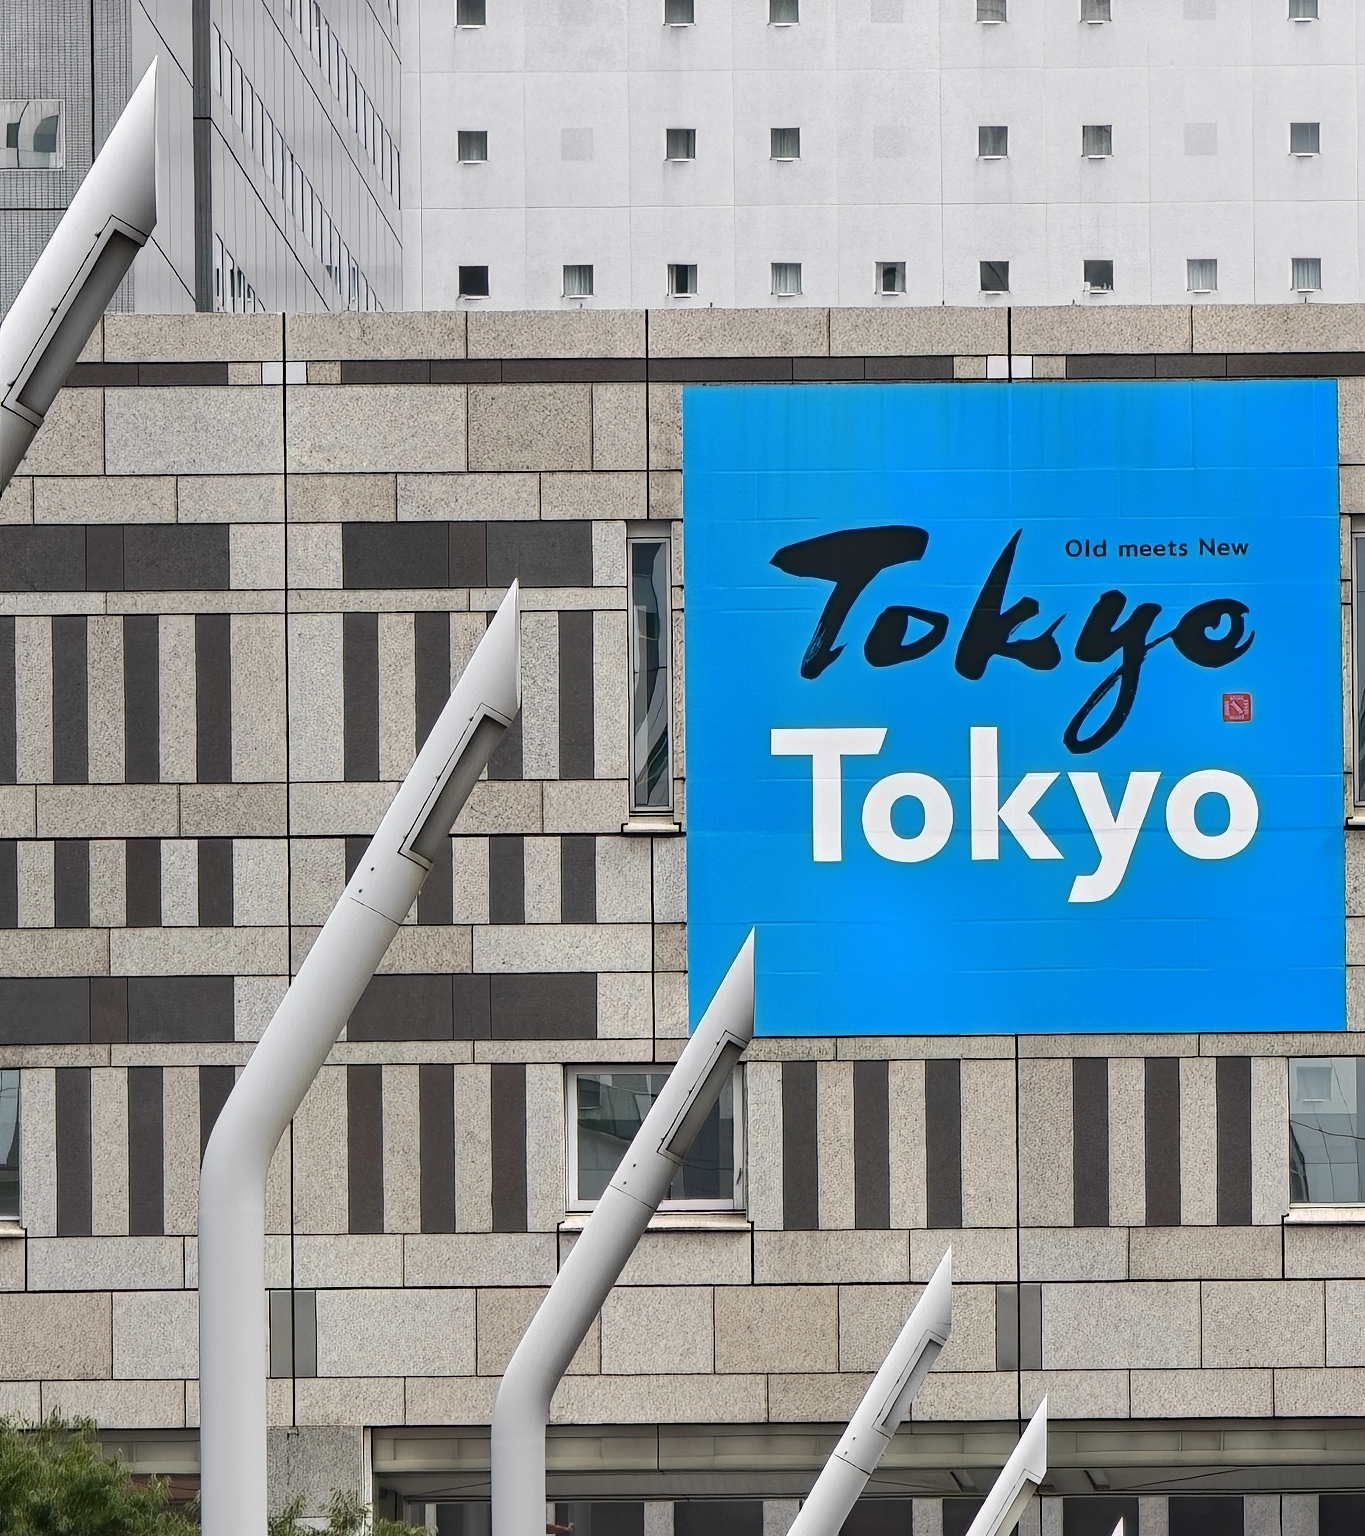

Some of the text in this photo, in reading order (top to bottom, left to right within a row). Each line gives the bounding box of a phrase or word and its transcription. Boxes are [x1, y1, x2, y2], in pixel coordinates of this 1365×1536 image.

[1065, 538, 1249, 558] Old meets New
[769, 525, 1255, 754] Tokyo
[771, 727, 1259, 903] Tokyo
